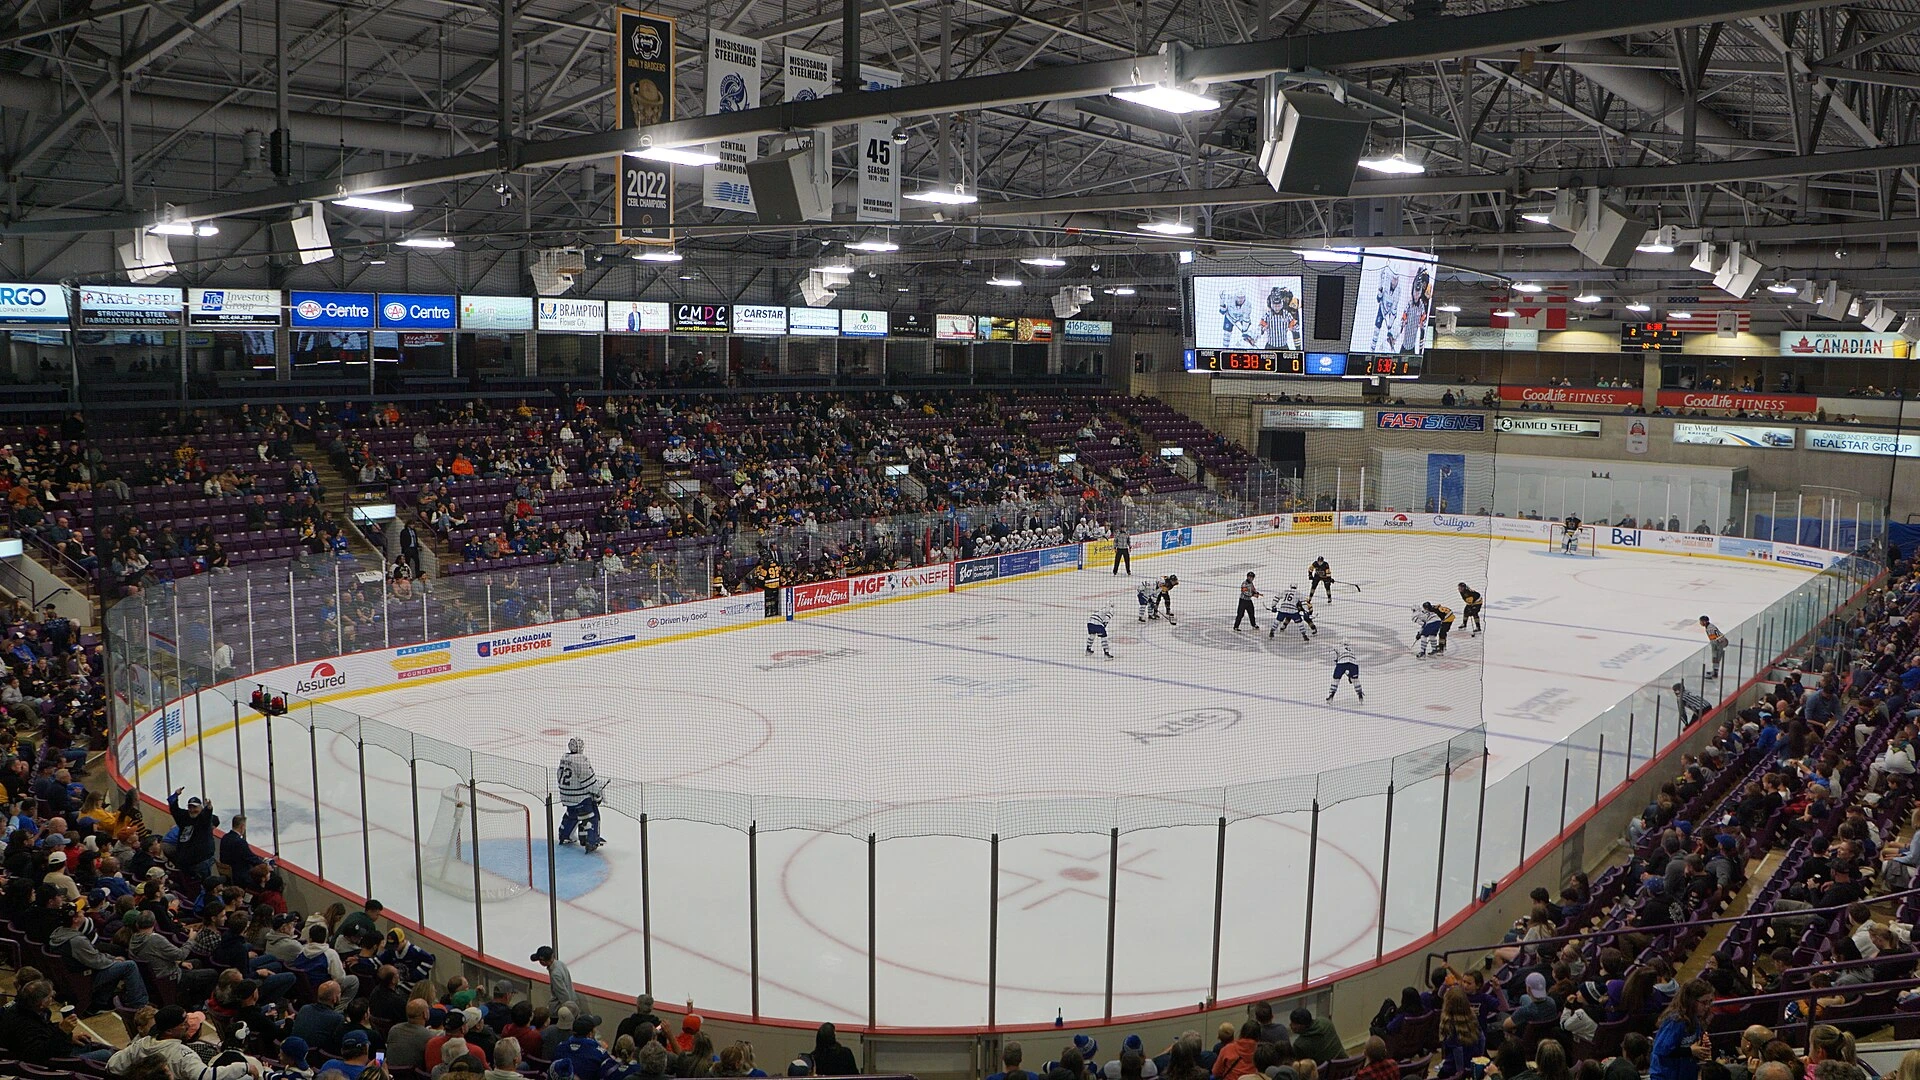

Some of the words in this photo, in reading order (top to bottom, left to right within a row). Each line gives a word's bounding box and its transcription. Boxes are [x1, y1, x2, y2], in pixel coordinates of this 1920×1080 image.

[715, 38, 757, 56] MISSISSAUGA
[715, 48, 756, 68] STEELHEADS
[789, 56, 828, 71] MISSISSAUGA
[789, 66, 828, 82] STEELHEADS
[720, 140, 746, 152] CENTRAL
[867, 138, 890, 165] 45
[719, 151, 747, 164] DIVISION
[867, 166, 890, 176] SEASONS
[627, 169, 667, 199] 2022
[711, 181, 751, 205] OHL
[639, 198, 667, 209] CHAMPIONS
[0, 288, 47, 306] RGO
[97, 293, 133, 305] AKAL
[137, 294, 178, 306] STEEL
[226, 292, 270, 303] Investors
[225, 301, 254, 311] Group
[326, 302, 369, 318] Centre
[387, 305, 404, 317] CAA
[410, 304, 451, 319] Centre
[559, 303, 604, 318] BRAMPTON
[744, 309, 784, 319] CARSTAR
[559, 318, 576, 326] Flower
[1066, 321, 1100, 333] 416Pages
[1815, 339, 1883, 354] CANADIAN
[1209, 357, 1217, 368] 2
[1230, 354, 1259, 369] 6:38
[1265, 359, 1272, 370] 2
[1292, 359, 1300, 371] 0
[1522, 388, 1566, 402] GoodLife
[1568, 393, 1614, 403] FITNESS
[1683, 394, 1733, 408] GoodLife
[1735, 399, 1785, 410] FITNESS
[1514, 421, 1547, 430] KIMCO
[1550, 422, 1581, 431] STEEL
[1813, 438, 1869, 451] REALSTAR
[1872, 442, 1912, 453] GROUP
[1384, 519, 1413, 527] Assured
[1433, 515, 1475, 531] Culligan
[1611, 528, 1641, 546] Bell
[853, 576, 885, 596] MGF
[796, 591, 812, 607] Tim
[813, 589, 848, 605] Hortons
[1283, 592, 1294, 602] 16
[580, 618, 620, 630] MAYFIELD
[660, 617, 681, 625] Driven
[681, 615, 689, 623] by
[690, 612, 708, 620] Good
[492, 638, 511, 647] REAL
[512, 631, 552, 643] CANADIAN
[401, 643, 447, 654] ARTWORKS
[492, 639, 552, 657] SUPERSTORE
[402, 666, 448, 677] FOUNDATION
[296, 672, 345, 694] Assured
